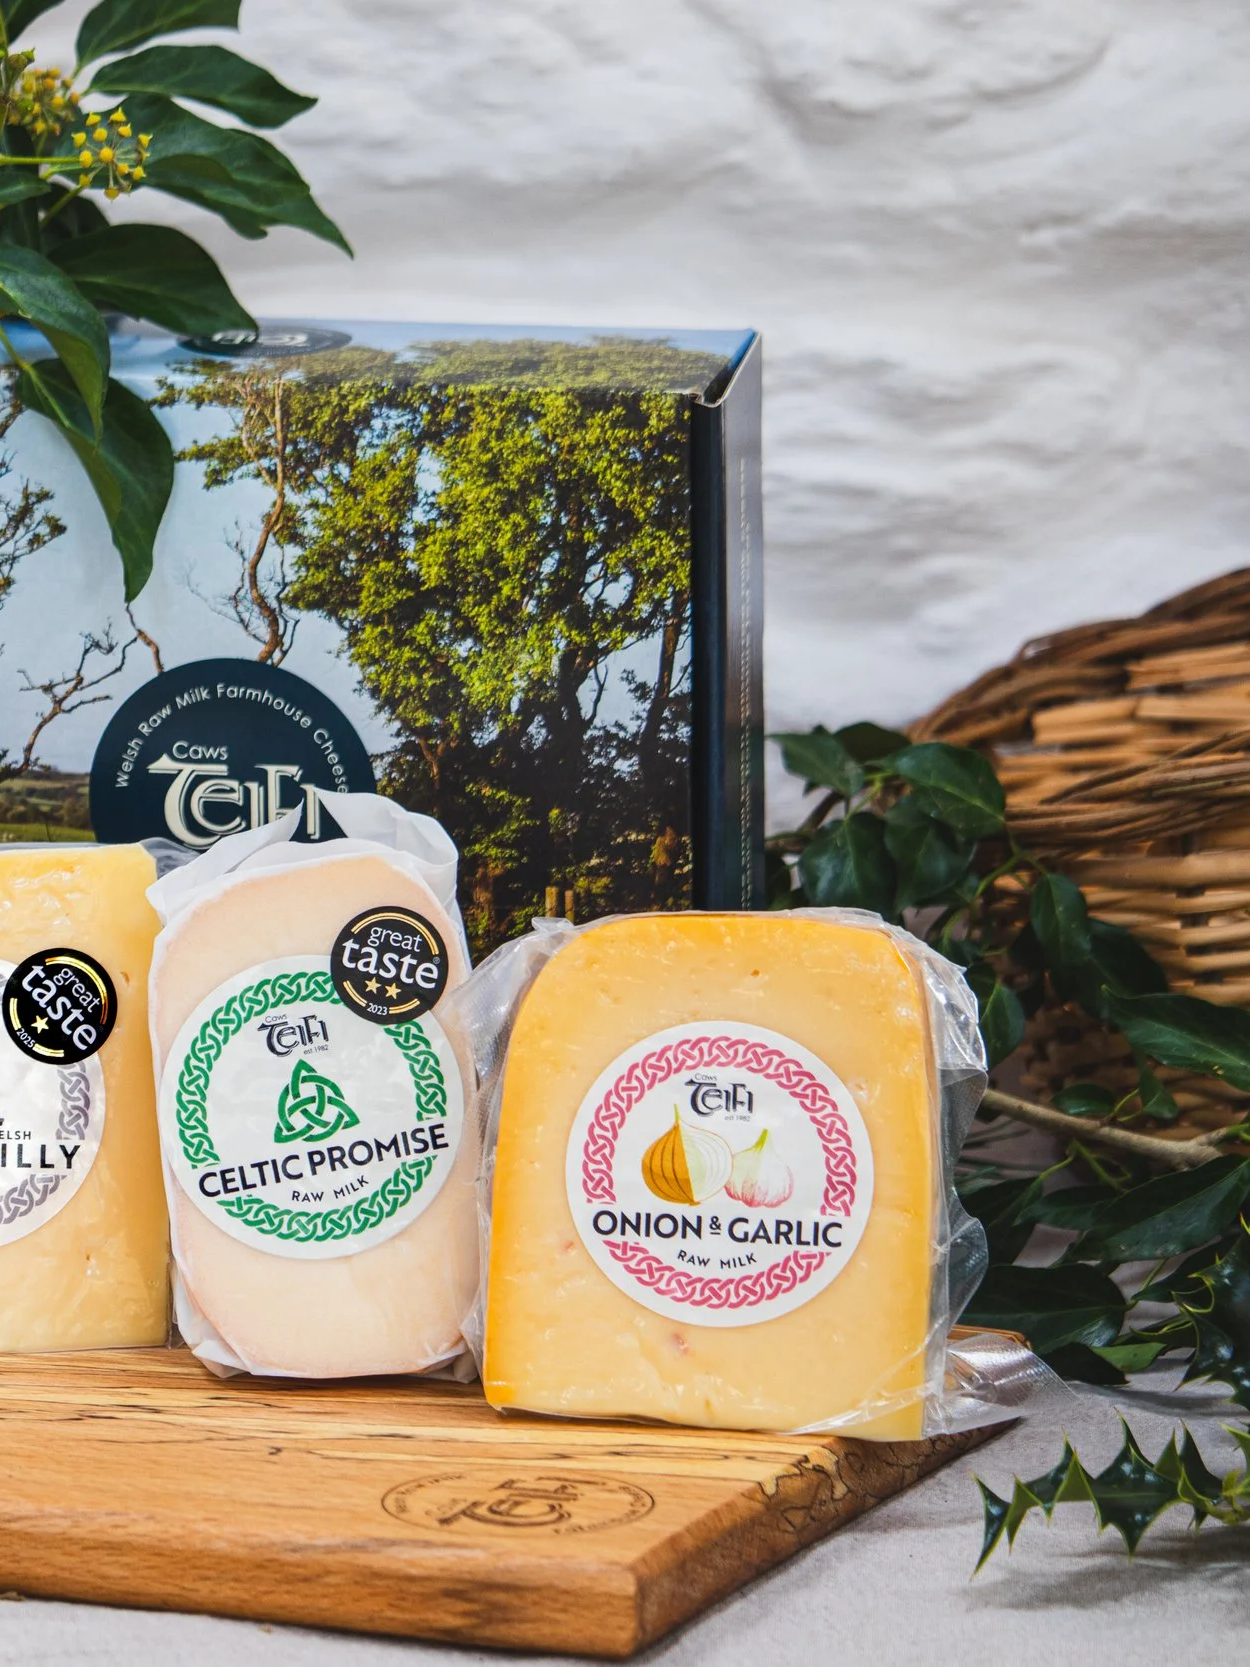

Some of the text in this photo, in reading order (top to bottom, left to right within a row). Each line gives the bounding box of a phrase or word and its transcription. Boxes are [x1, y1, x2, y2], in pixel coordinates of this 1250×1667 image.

[115, 736, 145, 789] Welsh
[137, 703, 173, 737] Raw
[175, 685, 211, 711] Milk
[215, 682, 313, 729] Farmhouse
[172, 740, 230, 761] Caws
[367, 925, 423, 953] great
[341, 937, 440, 990] taste
[53, 968, 101, 1013] great
[22, 965, 97, 1050] taste
[265, 1013, 288, 1023] Caws
[366, 1002, 389, 1016] 2023
[16, 1028, 36, 1048] 2025
[695, 1073, 717, 1081] Caws
[198, 1123, 450, 1199] CELTIC PROMISE
[292, 1175, 370, 1203] RAW MILK
[592, 1209, 843, 1248] ONION & GARLIC
[677, 1249, 758, 1269] RAW MILK
